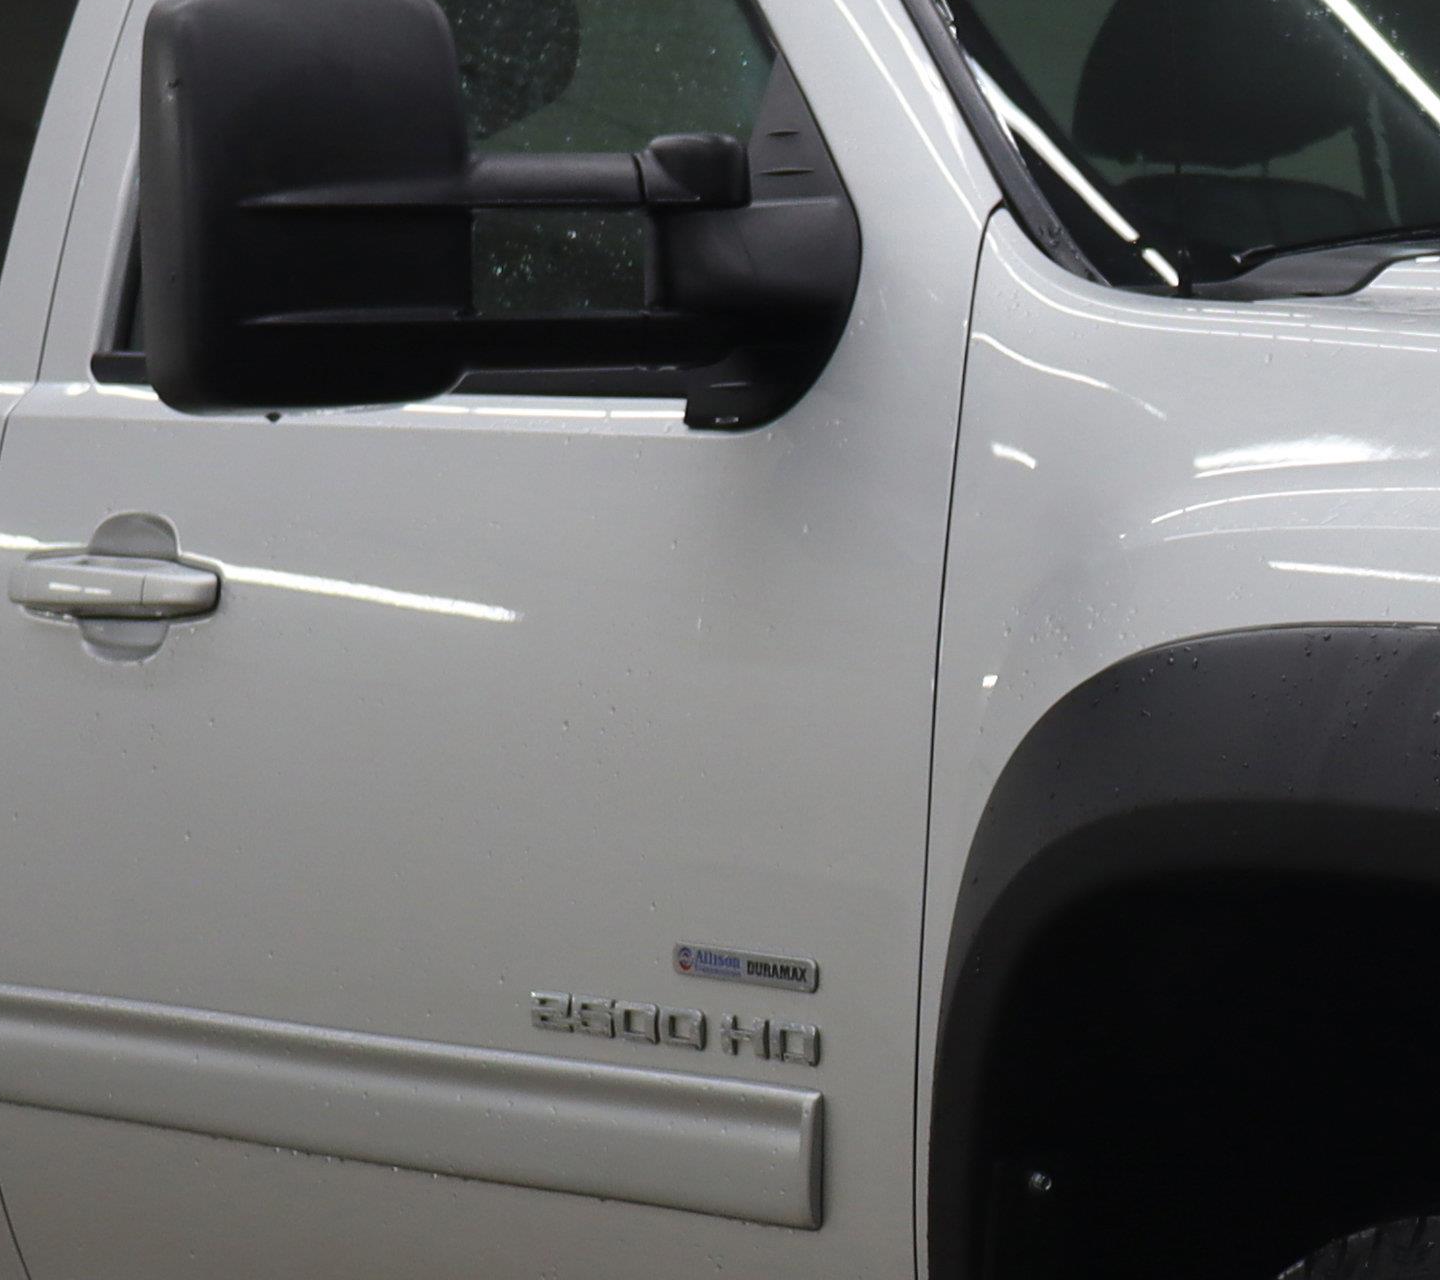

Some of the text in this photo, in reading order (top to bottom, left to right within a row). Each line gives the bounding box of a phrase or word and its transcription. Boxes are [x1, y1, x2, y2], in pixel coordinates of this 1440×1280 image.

[696, 949, 741, 970] Allison
[746, 959, 808, 983] DURAMAX
[531, 991, 821, 1068] 2500 HD
